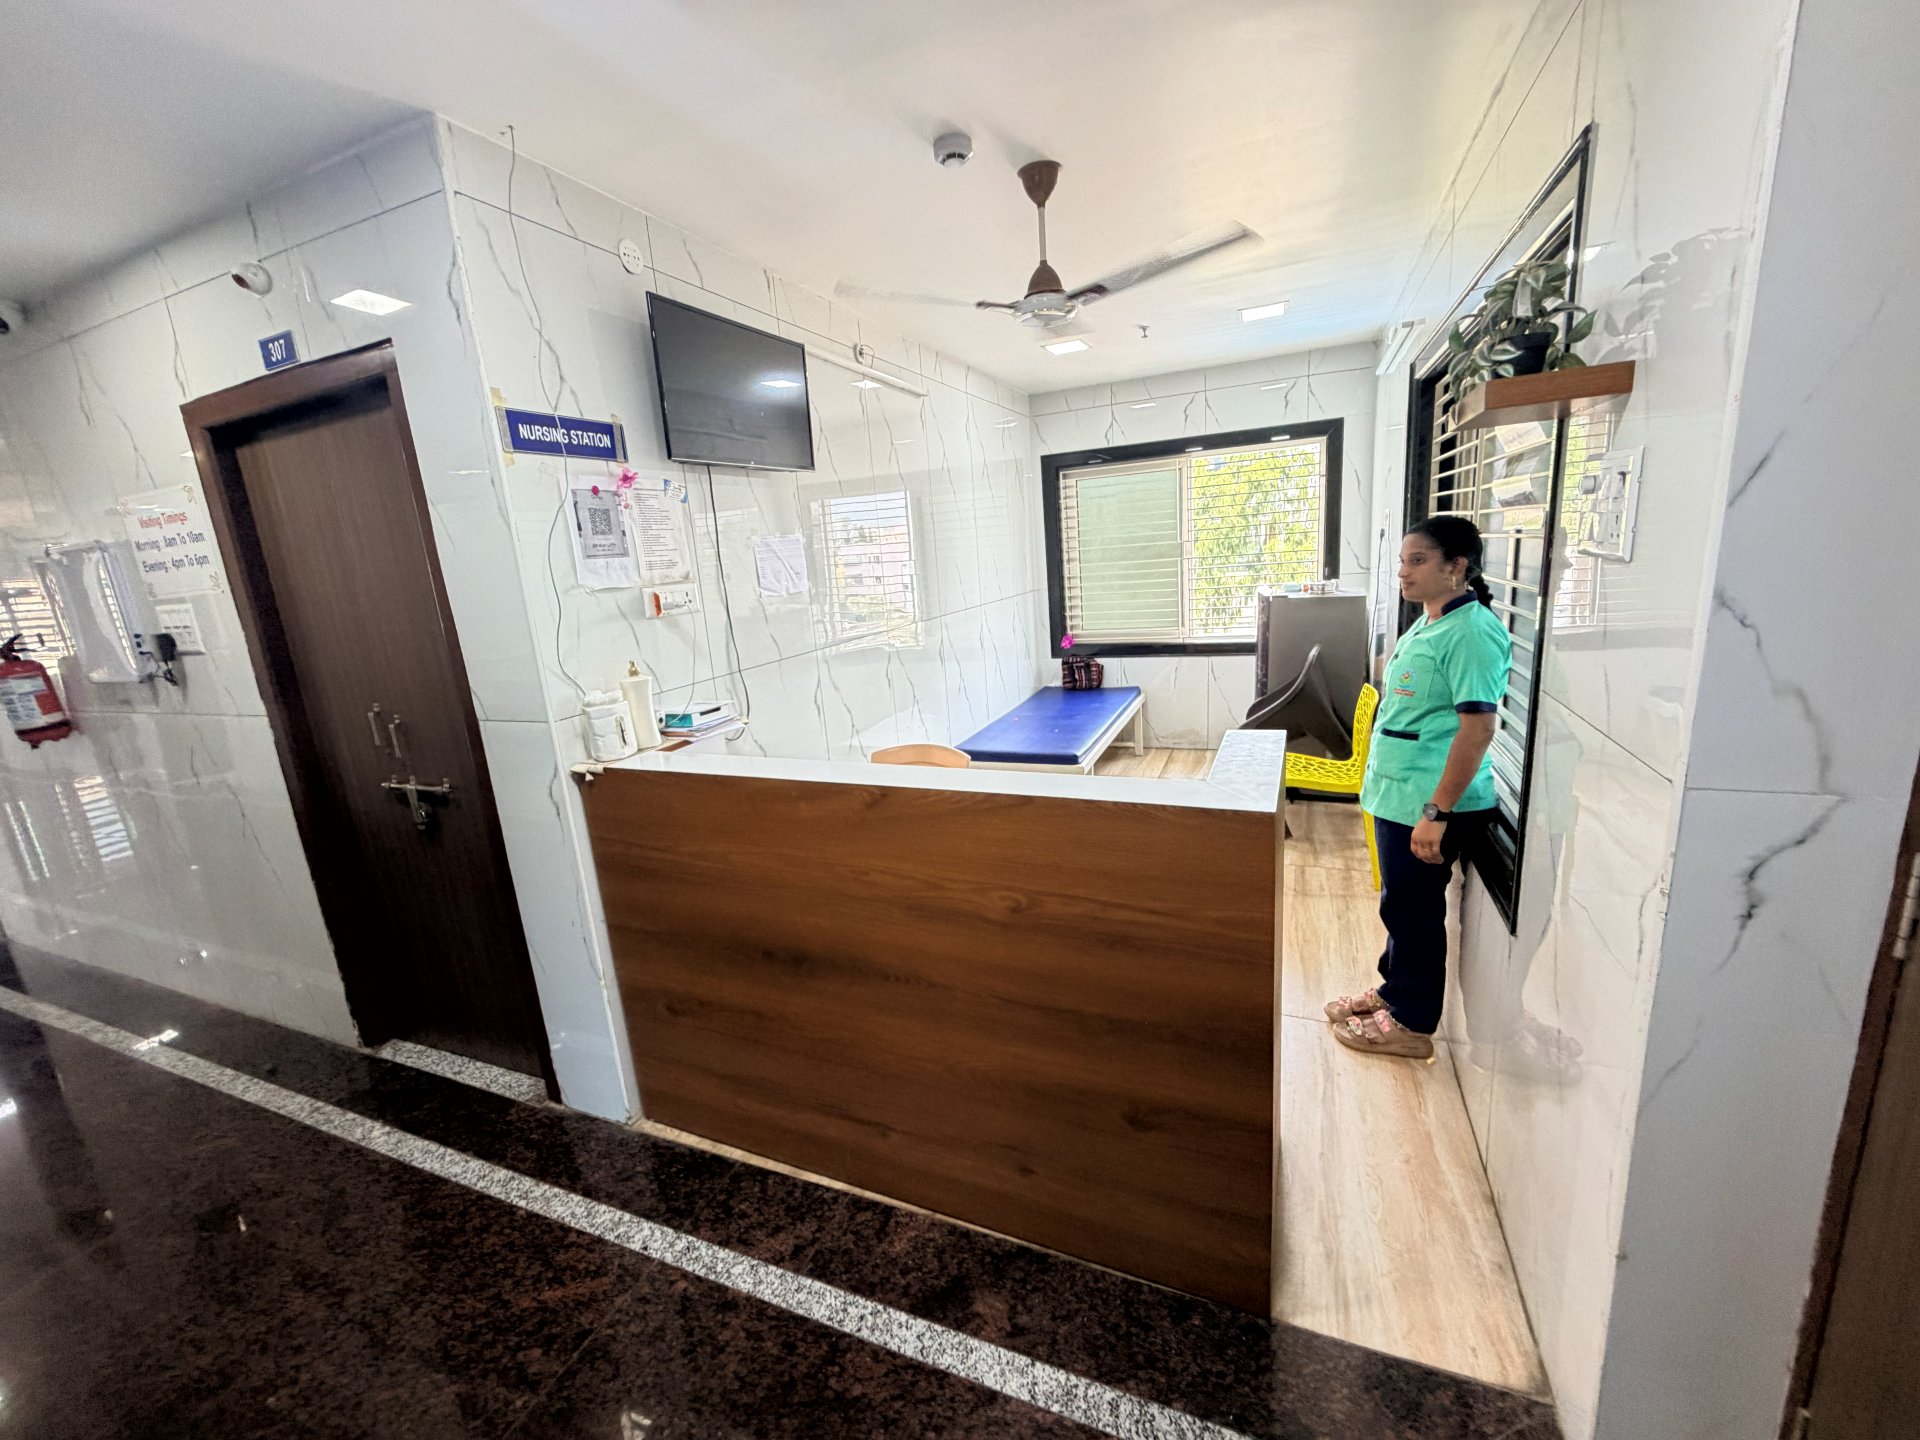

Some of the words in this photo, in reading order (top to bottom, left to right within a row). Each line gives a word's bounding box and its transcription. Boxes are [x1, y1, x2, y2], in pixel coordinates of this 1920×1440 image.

[268, 339, 287, 362] 307
[518, 423, 568, 444] NURSING
[570, 430, 612, 449] STATION
[138, 515, 163, 529] Visiting
[161, 511, 188, 525] Timings
[135, 539, 161, 552] Morning
[177, 533, 186, 545] To
[186, 531, 206, 544] 10am
[142, 560, 168, 573] Evening
[172, 557, 185, 571] 4pm
[185, 555, 194, 567] To
[194, 553, 210, 568] 6pm
